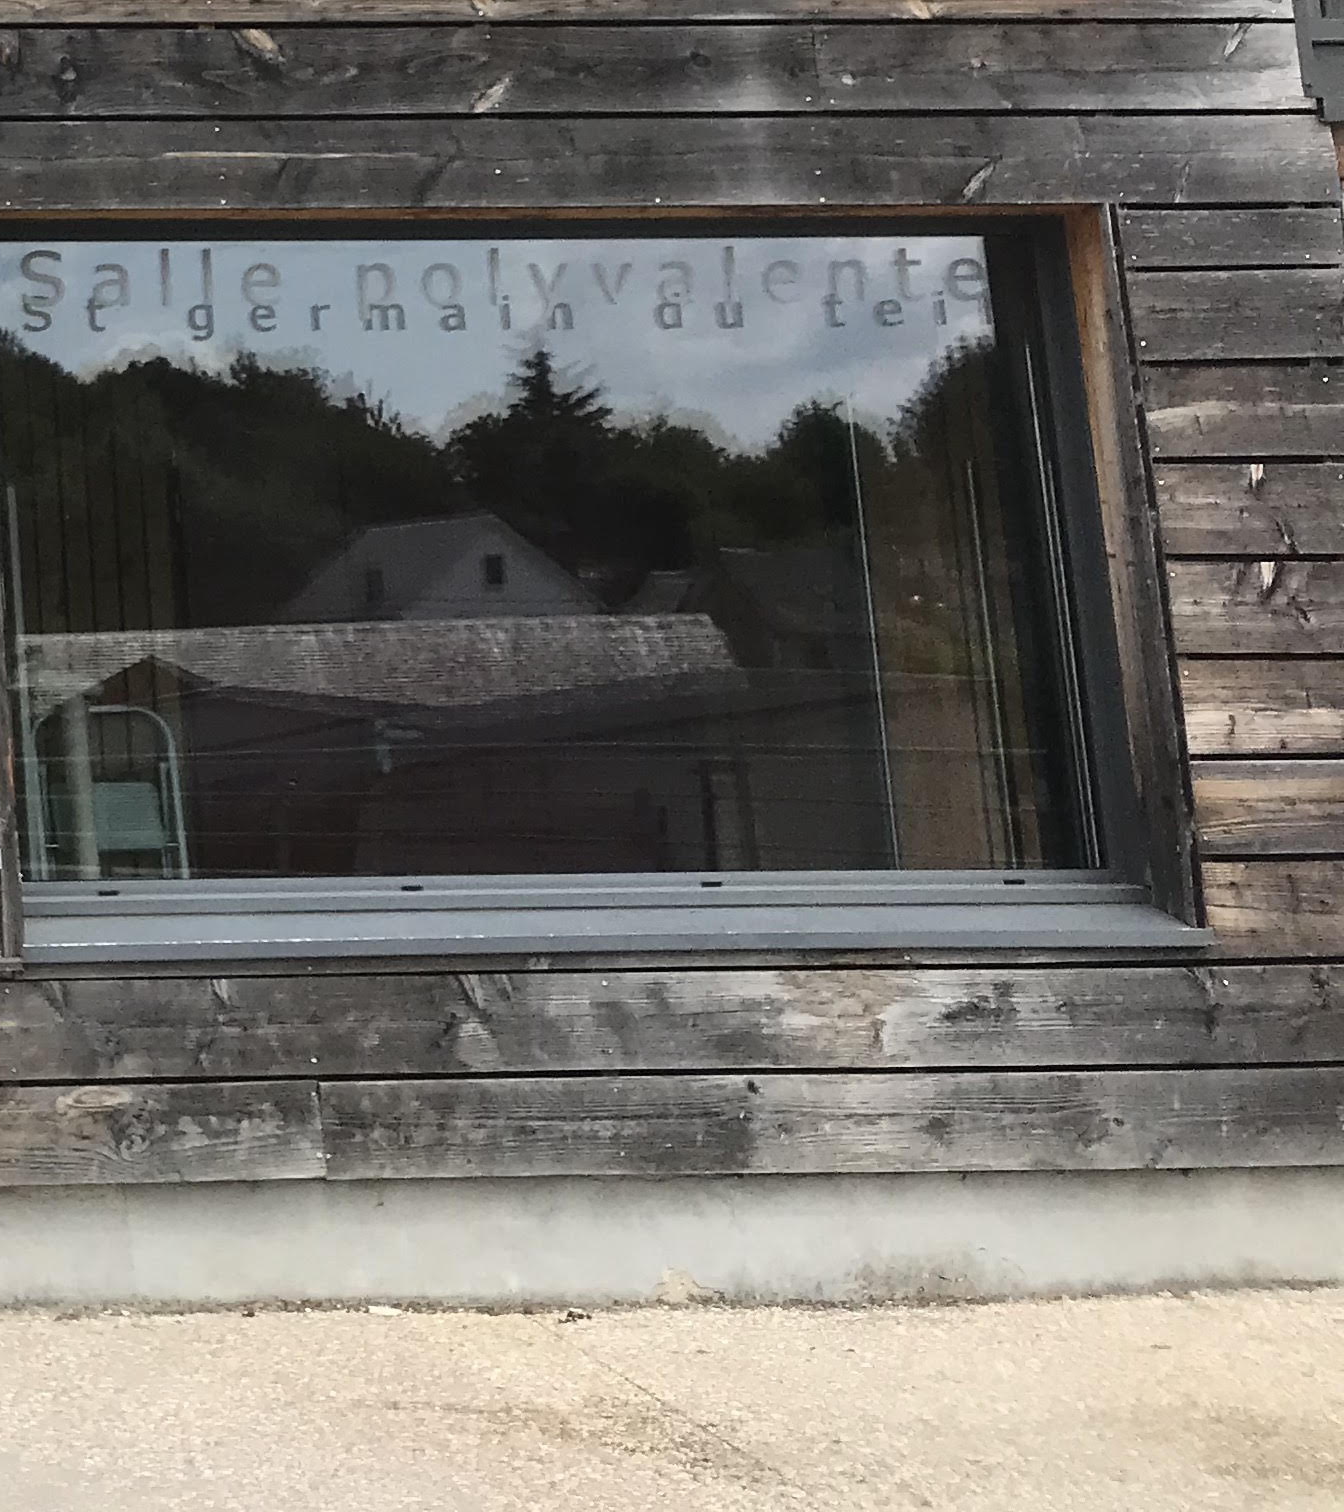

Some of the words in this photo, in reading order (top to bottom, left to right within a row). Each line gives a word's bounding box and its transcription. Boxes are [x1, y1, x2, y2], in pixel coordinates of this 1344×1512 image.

[19, 248, 283, 308] Salle
[355, 245, 987, 322] polyvalente
[187, 293, 575, 341] germain
[653, 290, 745, 330] du
